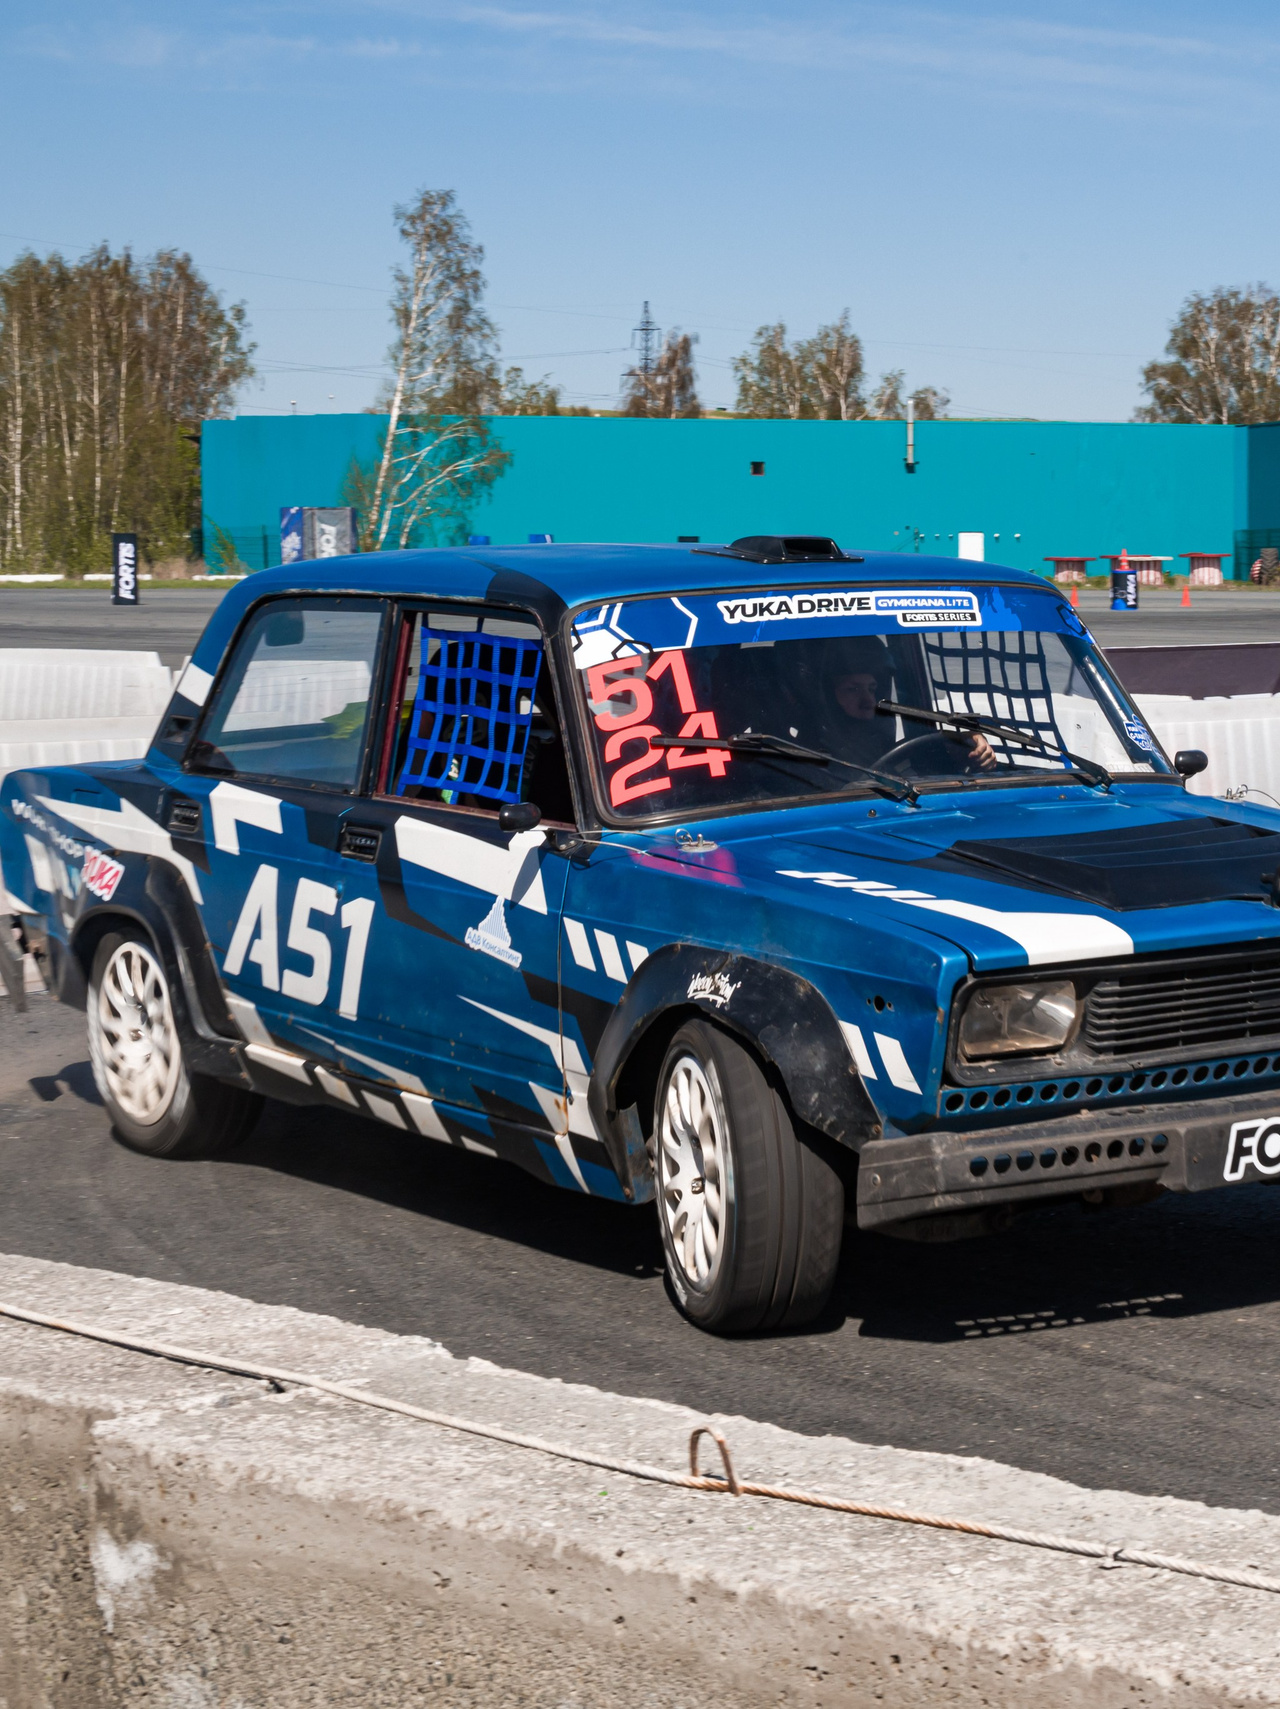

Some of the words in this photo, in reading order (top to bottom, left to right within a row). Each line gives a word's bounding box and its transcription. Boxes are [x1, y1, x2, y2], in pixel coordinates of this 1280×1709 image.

[118, 541, 136, 600] FORTIS
[723, 602, 793, 620] YUKA
[798, 596, 872, 615] DRIVE
[877, 597, 945, 608] GYMKHANA
[946, 598, 970, 608] LITE
[905, 612, 937, 623] FORTIS
[938, 612, 972, 622] SERIES
[586, 650, 697, 733] 51
[604, 711, 732, 808] 24
[222, 863, 376, 1021] A51
